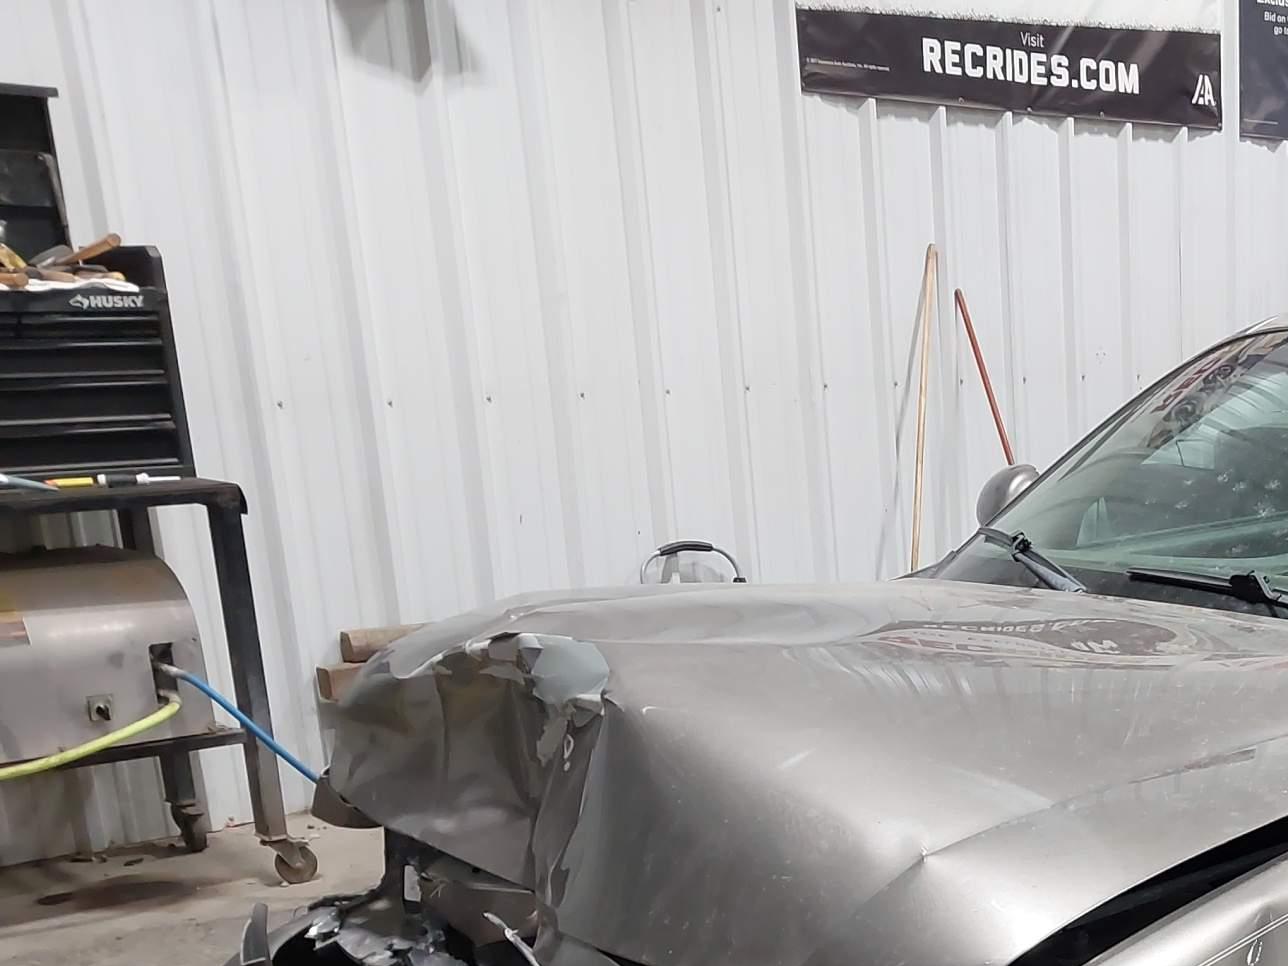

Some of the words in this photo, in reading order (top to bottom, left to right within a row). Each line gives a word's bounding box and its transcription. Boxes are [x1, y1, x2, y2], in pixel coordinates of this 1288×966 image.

[1264, 11, 1276, 22] Bid
[1277, 15, 1286, 23] on
[1273, 26, 1282, 35] go
[1020, 31, 1044, 48] Visit
[922, 37, 1140, 95] RECRIDES.COM
[89, 295, 144, 308] HUSKY
